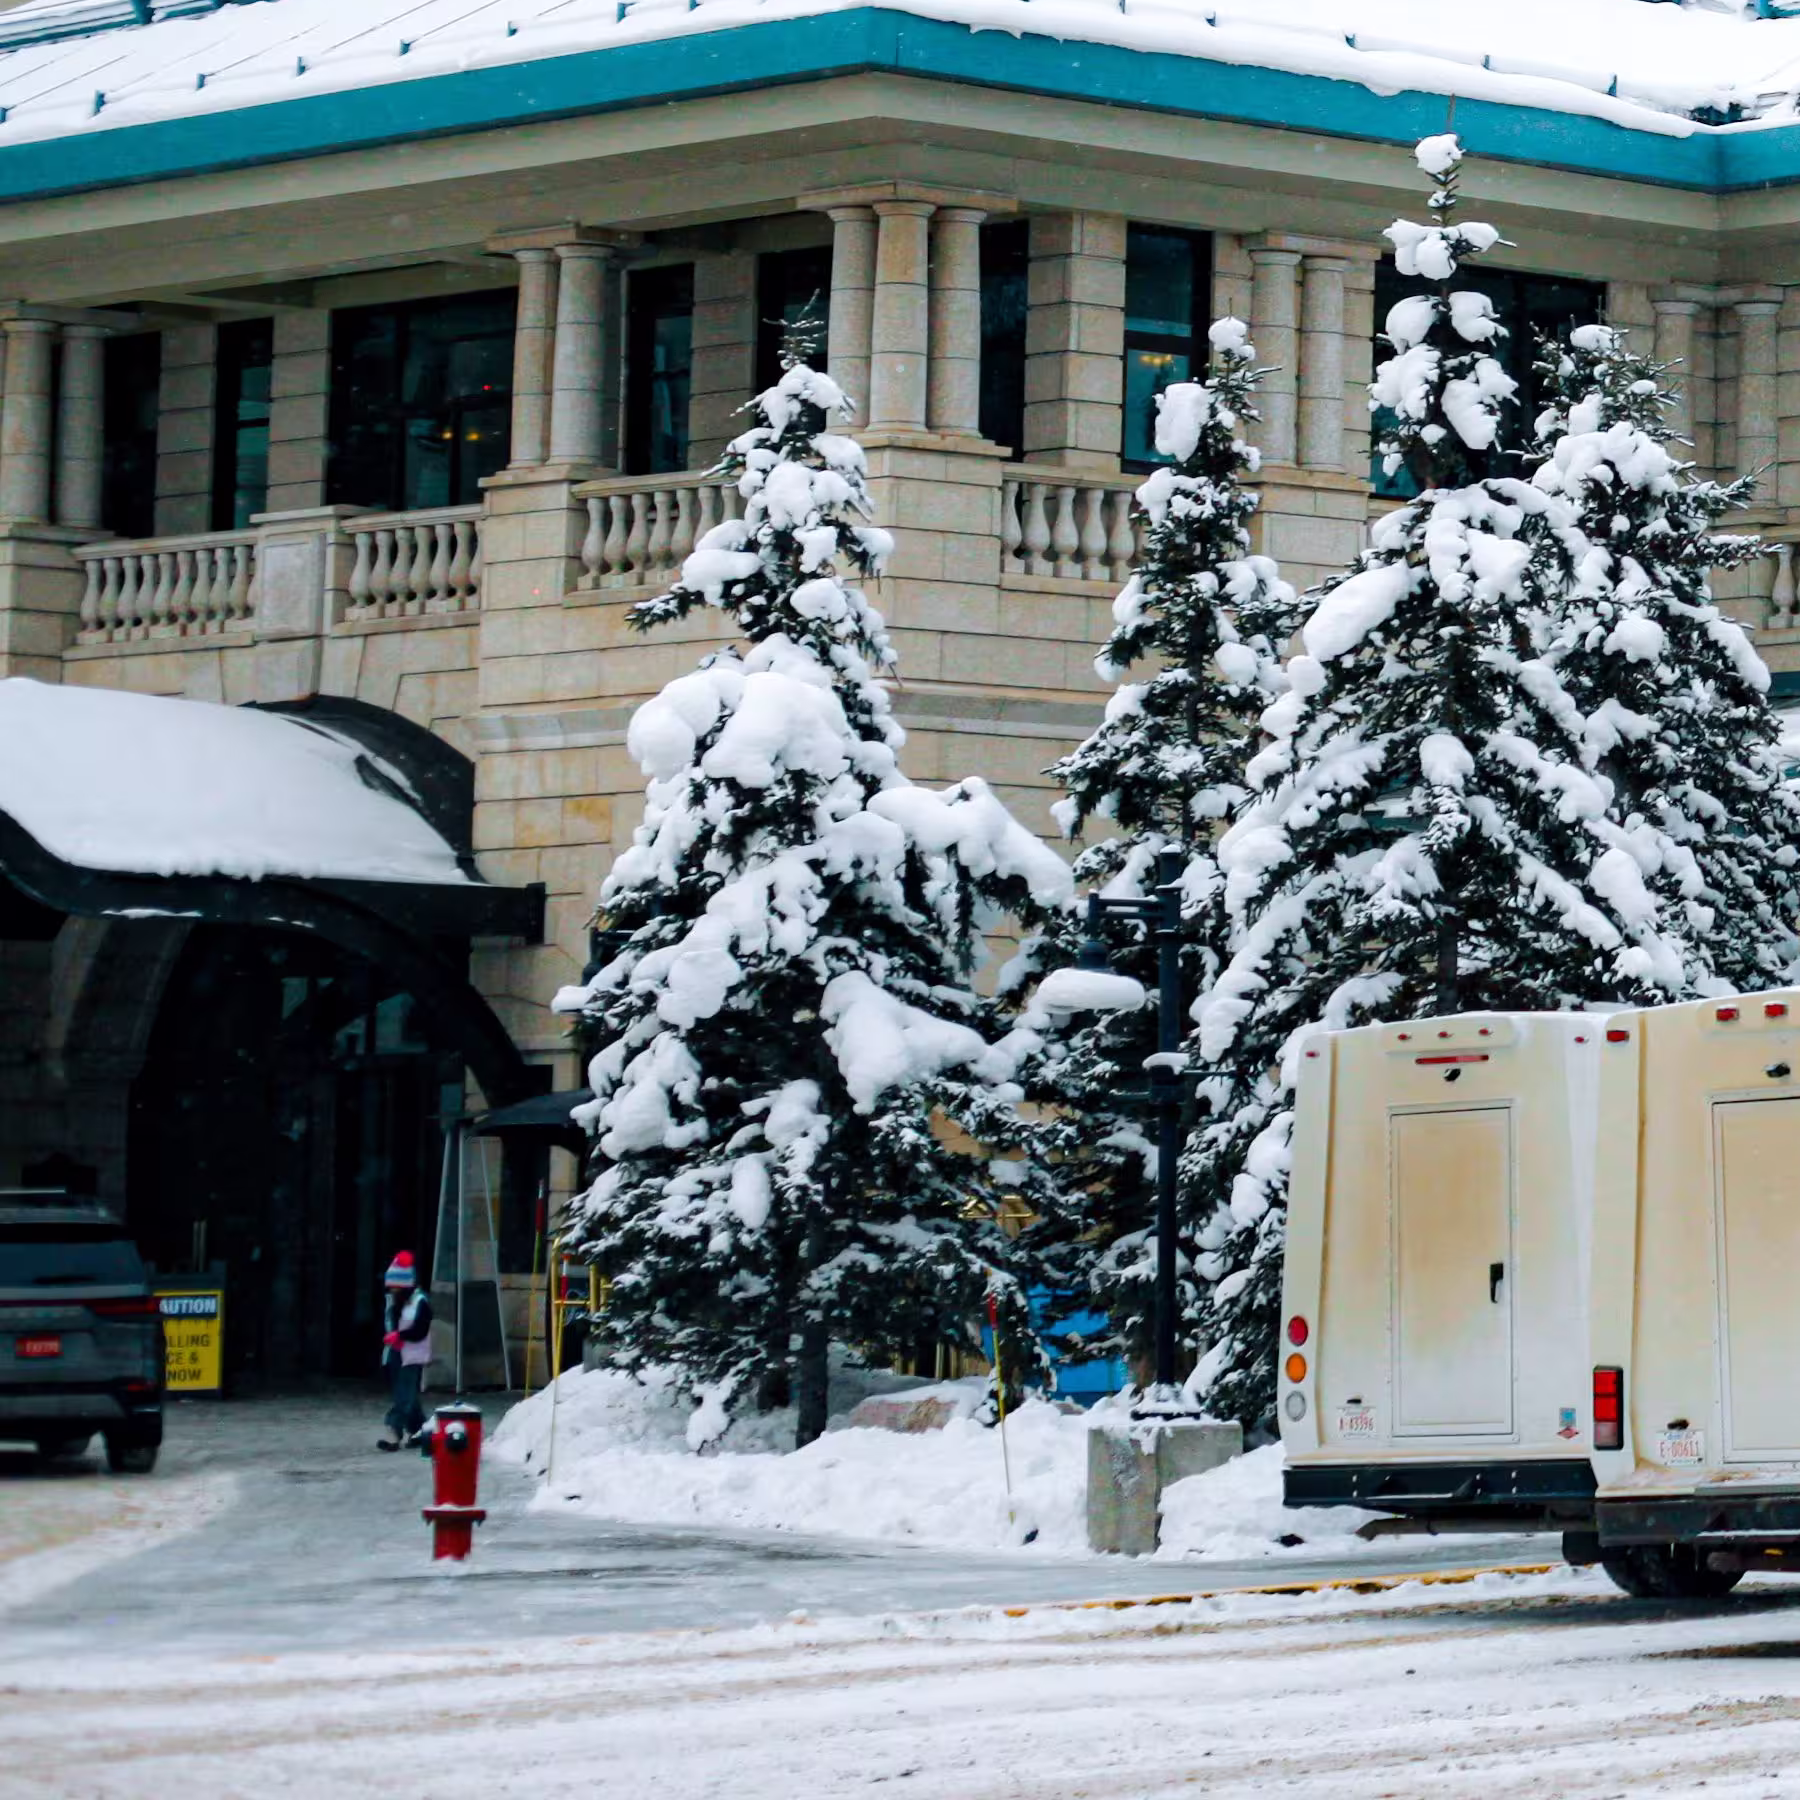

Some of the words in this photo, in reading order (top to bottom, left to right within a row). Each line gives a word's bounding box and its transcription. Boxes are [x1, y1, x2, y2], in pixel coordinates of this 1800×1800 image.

[159, 1297, 217, 1314] AUTION
[167, 1333, 211, 1348] LLING
[166, 1351, 187, 1365] CE
[189, 1351, 199, 1365] &
[167, 1368, 202, 1382] NOW
